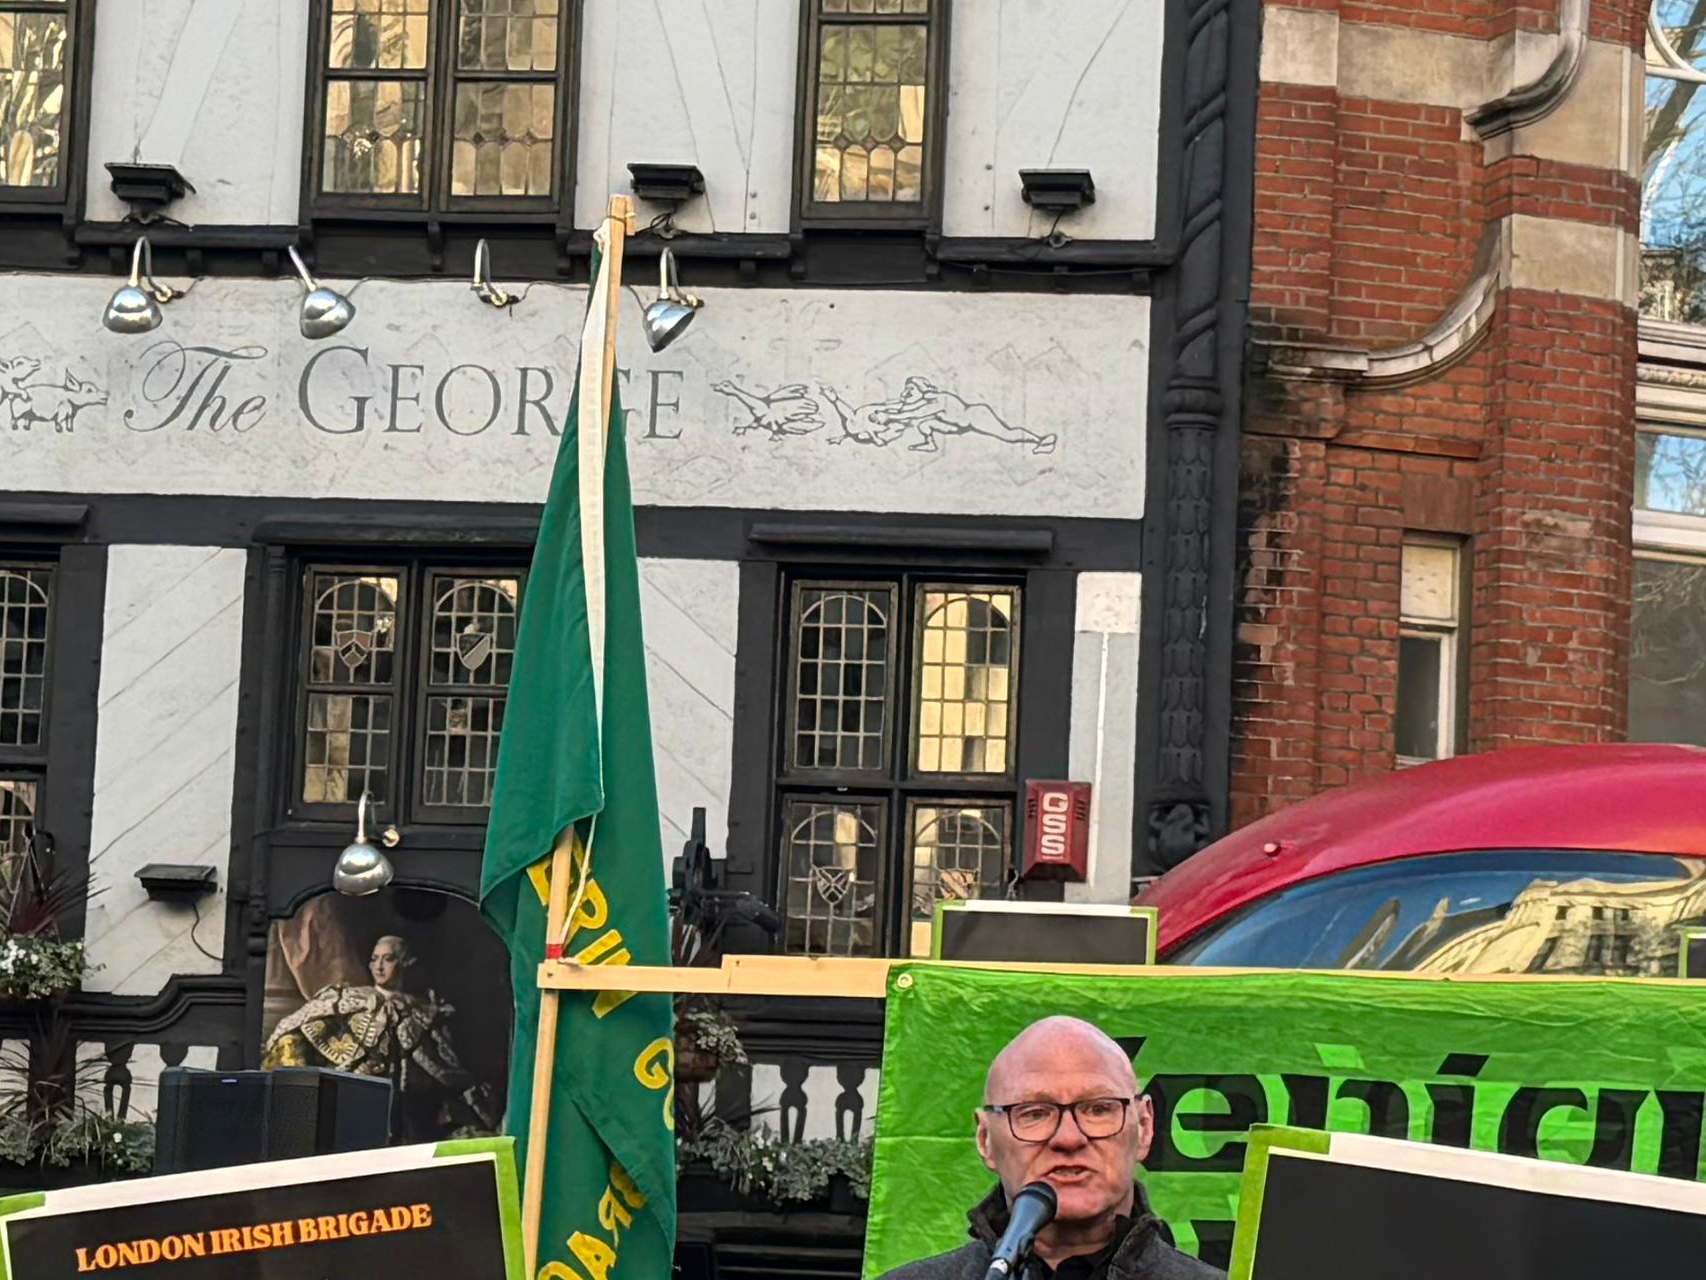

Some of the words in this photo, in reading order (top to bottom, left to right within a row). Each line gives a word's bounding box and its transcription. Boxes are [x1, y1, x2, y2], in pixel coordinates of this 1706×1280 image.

[123, 340, 268, 433] The
[298, 346, 684, 440] GEORE
[76, 1232, 204, 1272] LONDON
[209, 1221, 294, 1255] IRISH
[297, 1203, 433, 1242] BRIGADE
